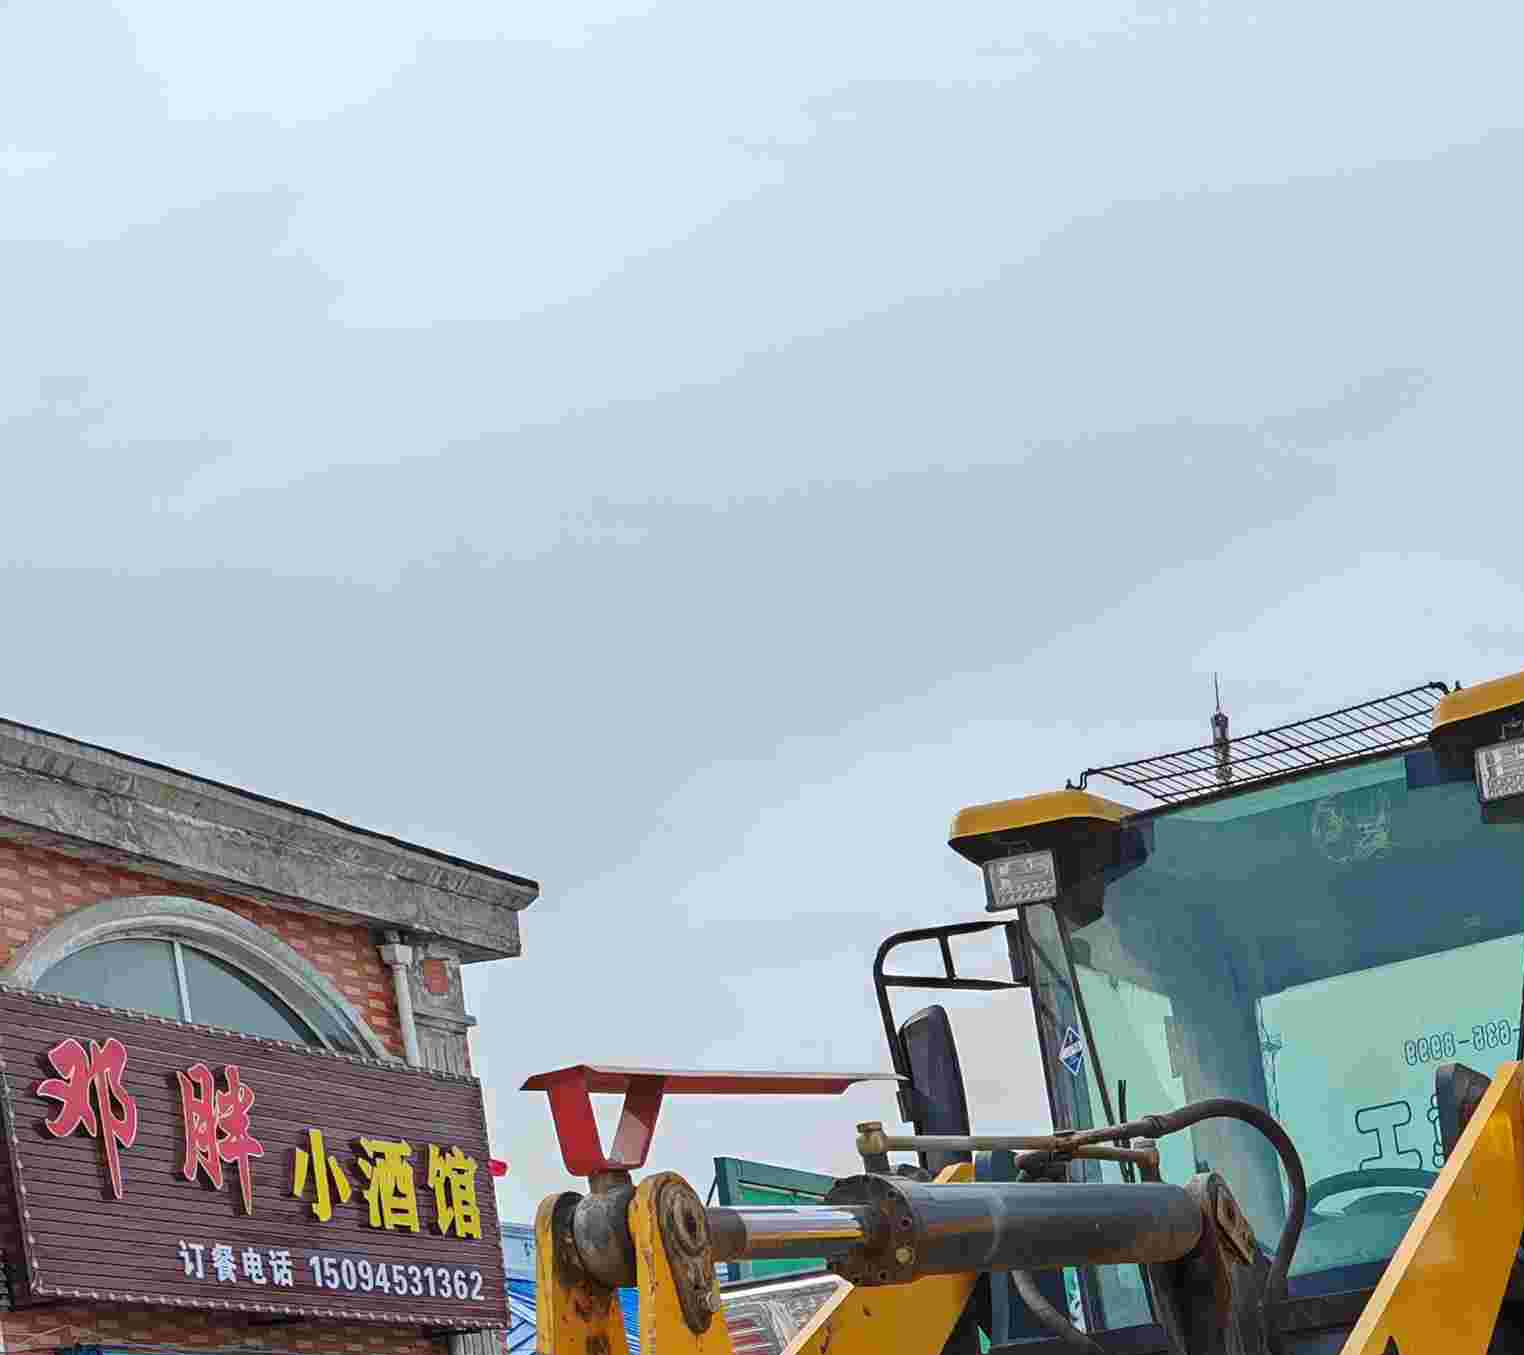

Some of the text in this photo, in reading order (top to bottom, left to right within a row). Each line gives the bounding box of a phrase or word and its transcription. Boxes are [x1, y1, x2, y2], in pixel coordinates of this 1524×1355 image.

[179, 1240, 485, 1300] 订餐电话 15094531362
